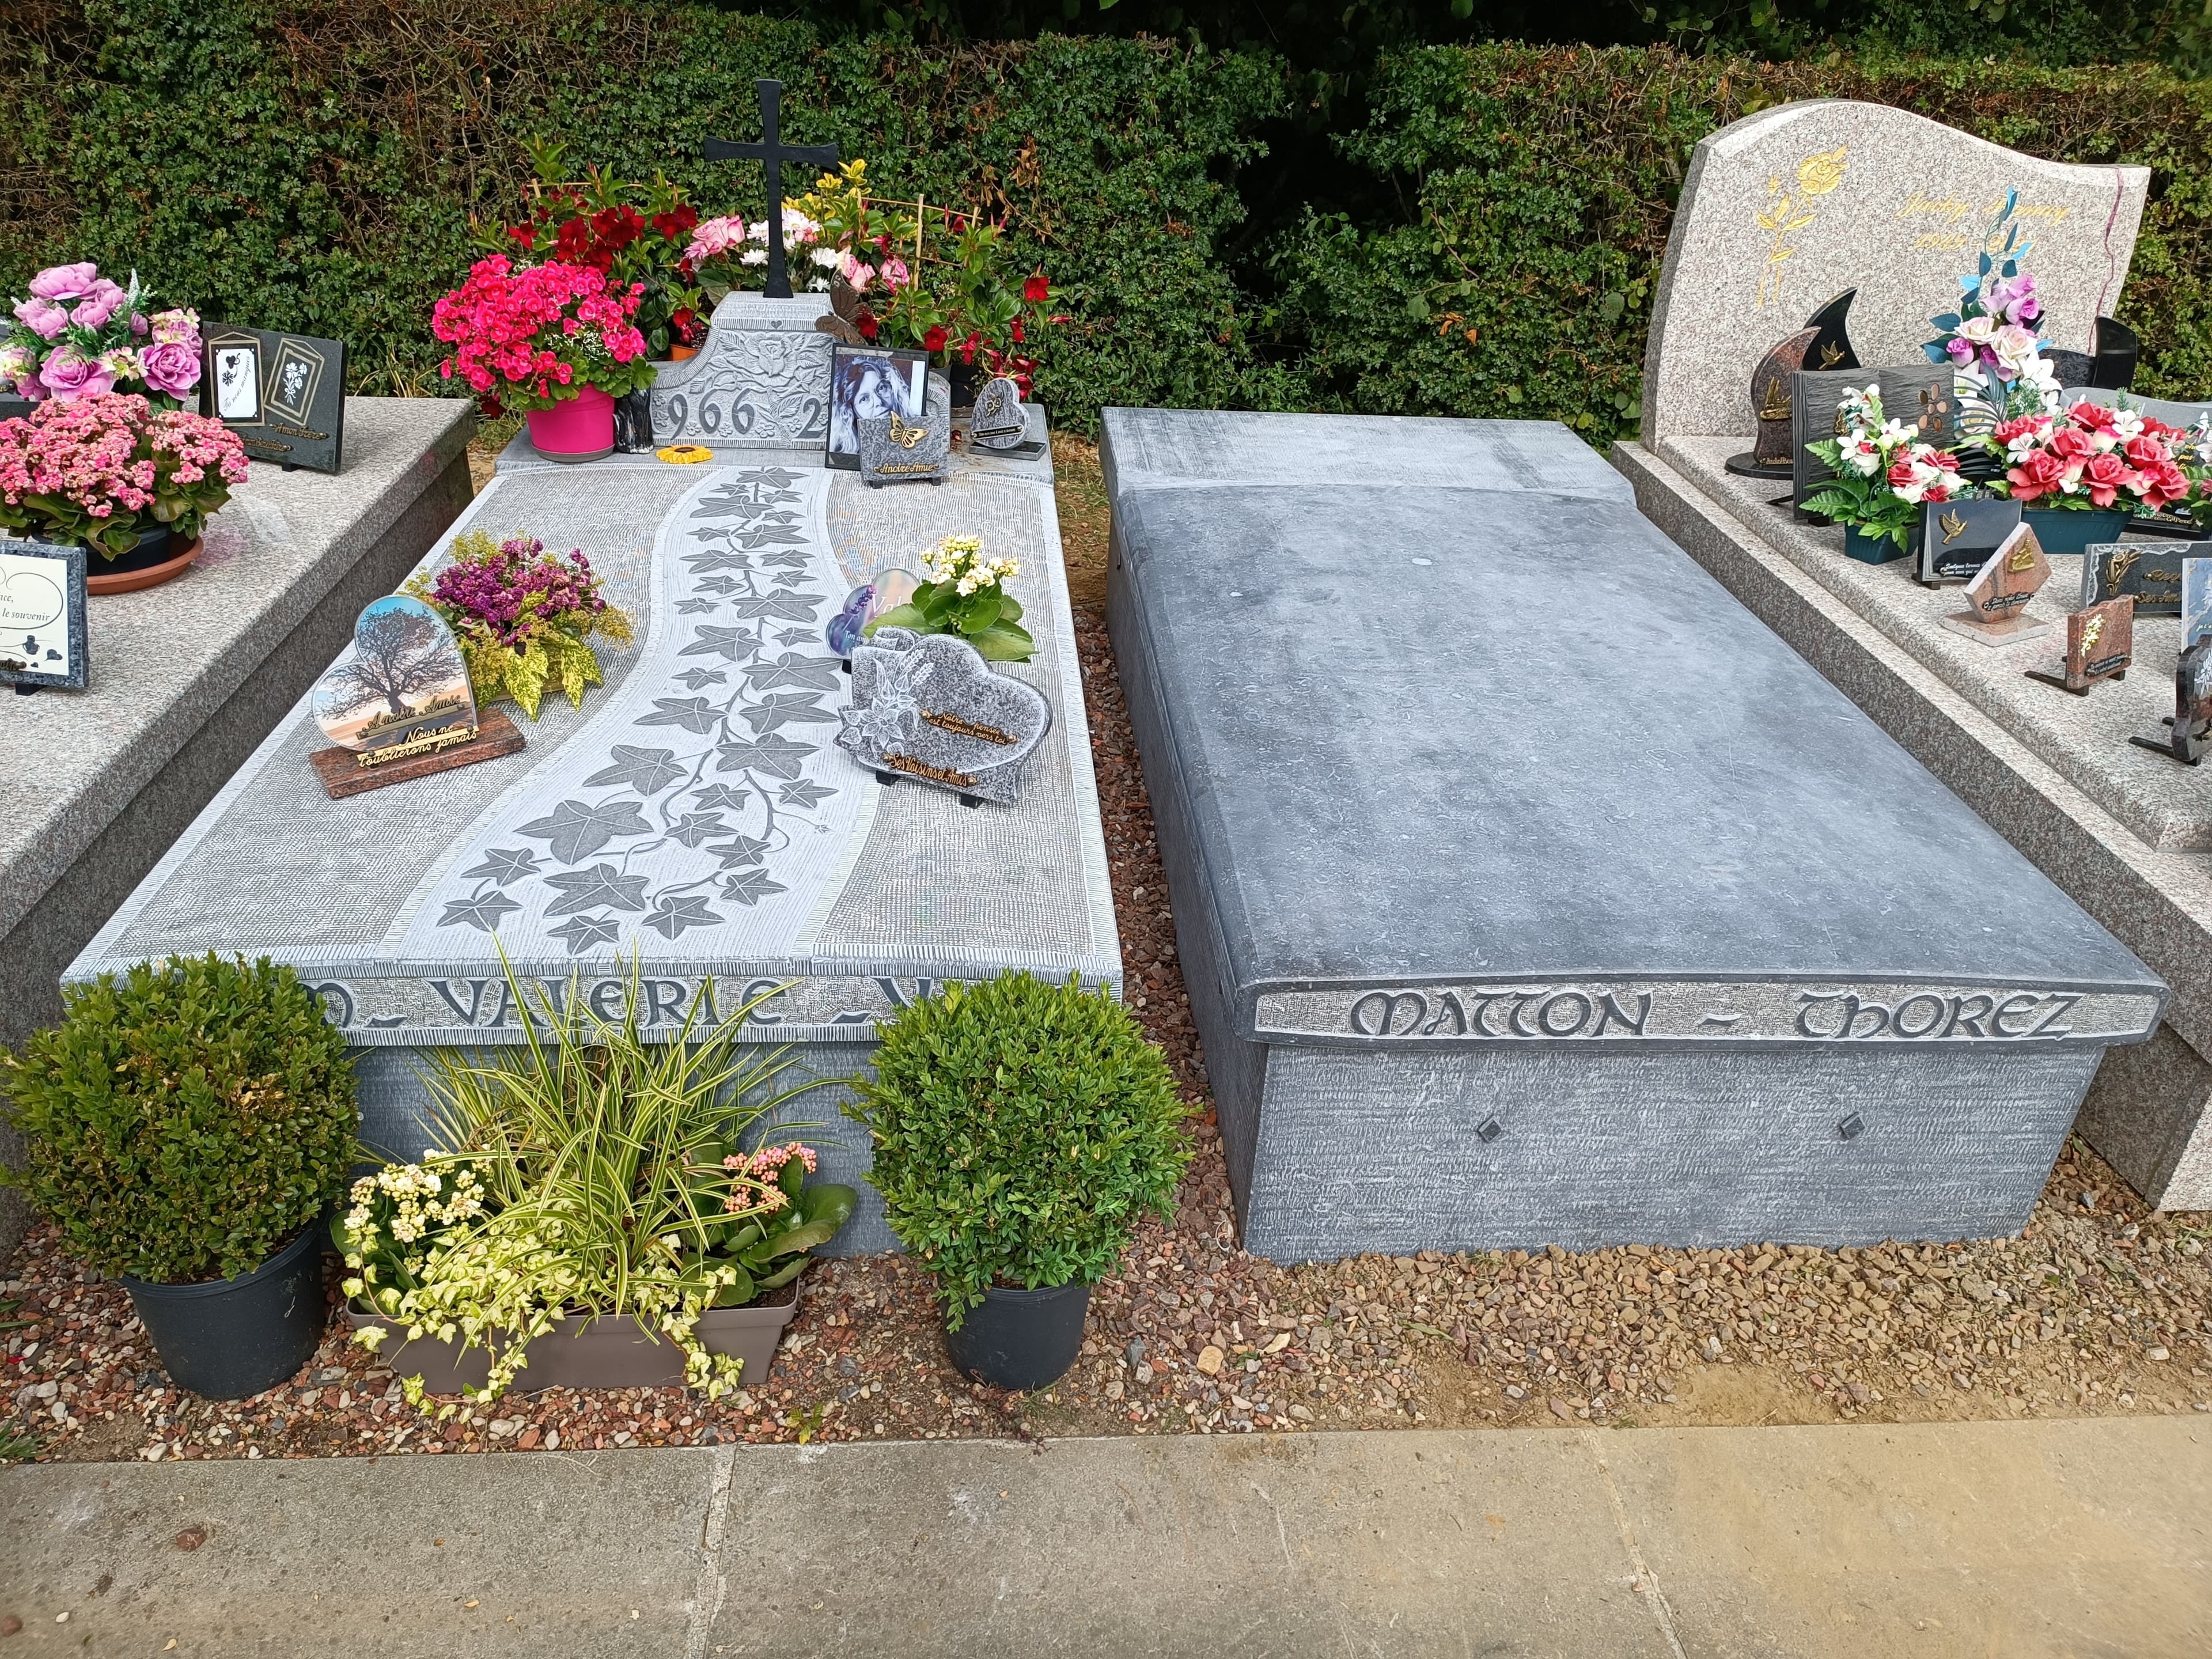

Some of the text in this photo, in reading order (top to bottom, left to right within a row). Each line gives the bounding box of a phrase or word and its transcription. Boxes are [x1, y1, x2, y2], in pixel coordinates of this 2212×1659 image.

[2, 608, 50, 622] le souvenir
[844, 630, 855, 640] Ton
[938, 712, 963, 724] Notre
[398, 724, 454, 747] Nous ne
[942, 721, 974, 736] toujours
[435, 731, 477, 753] jamais
[1350, 988, 1652, 1037] MATTON
